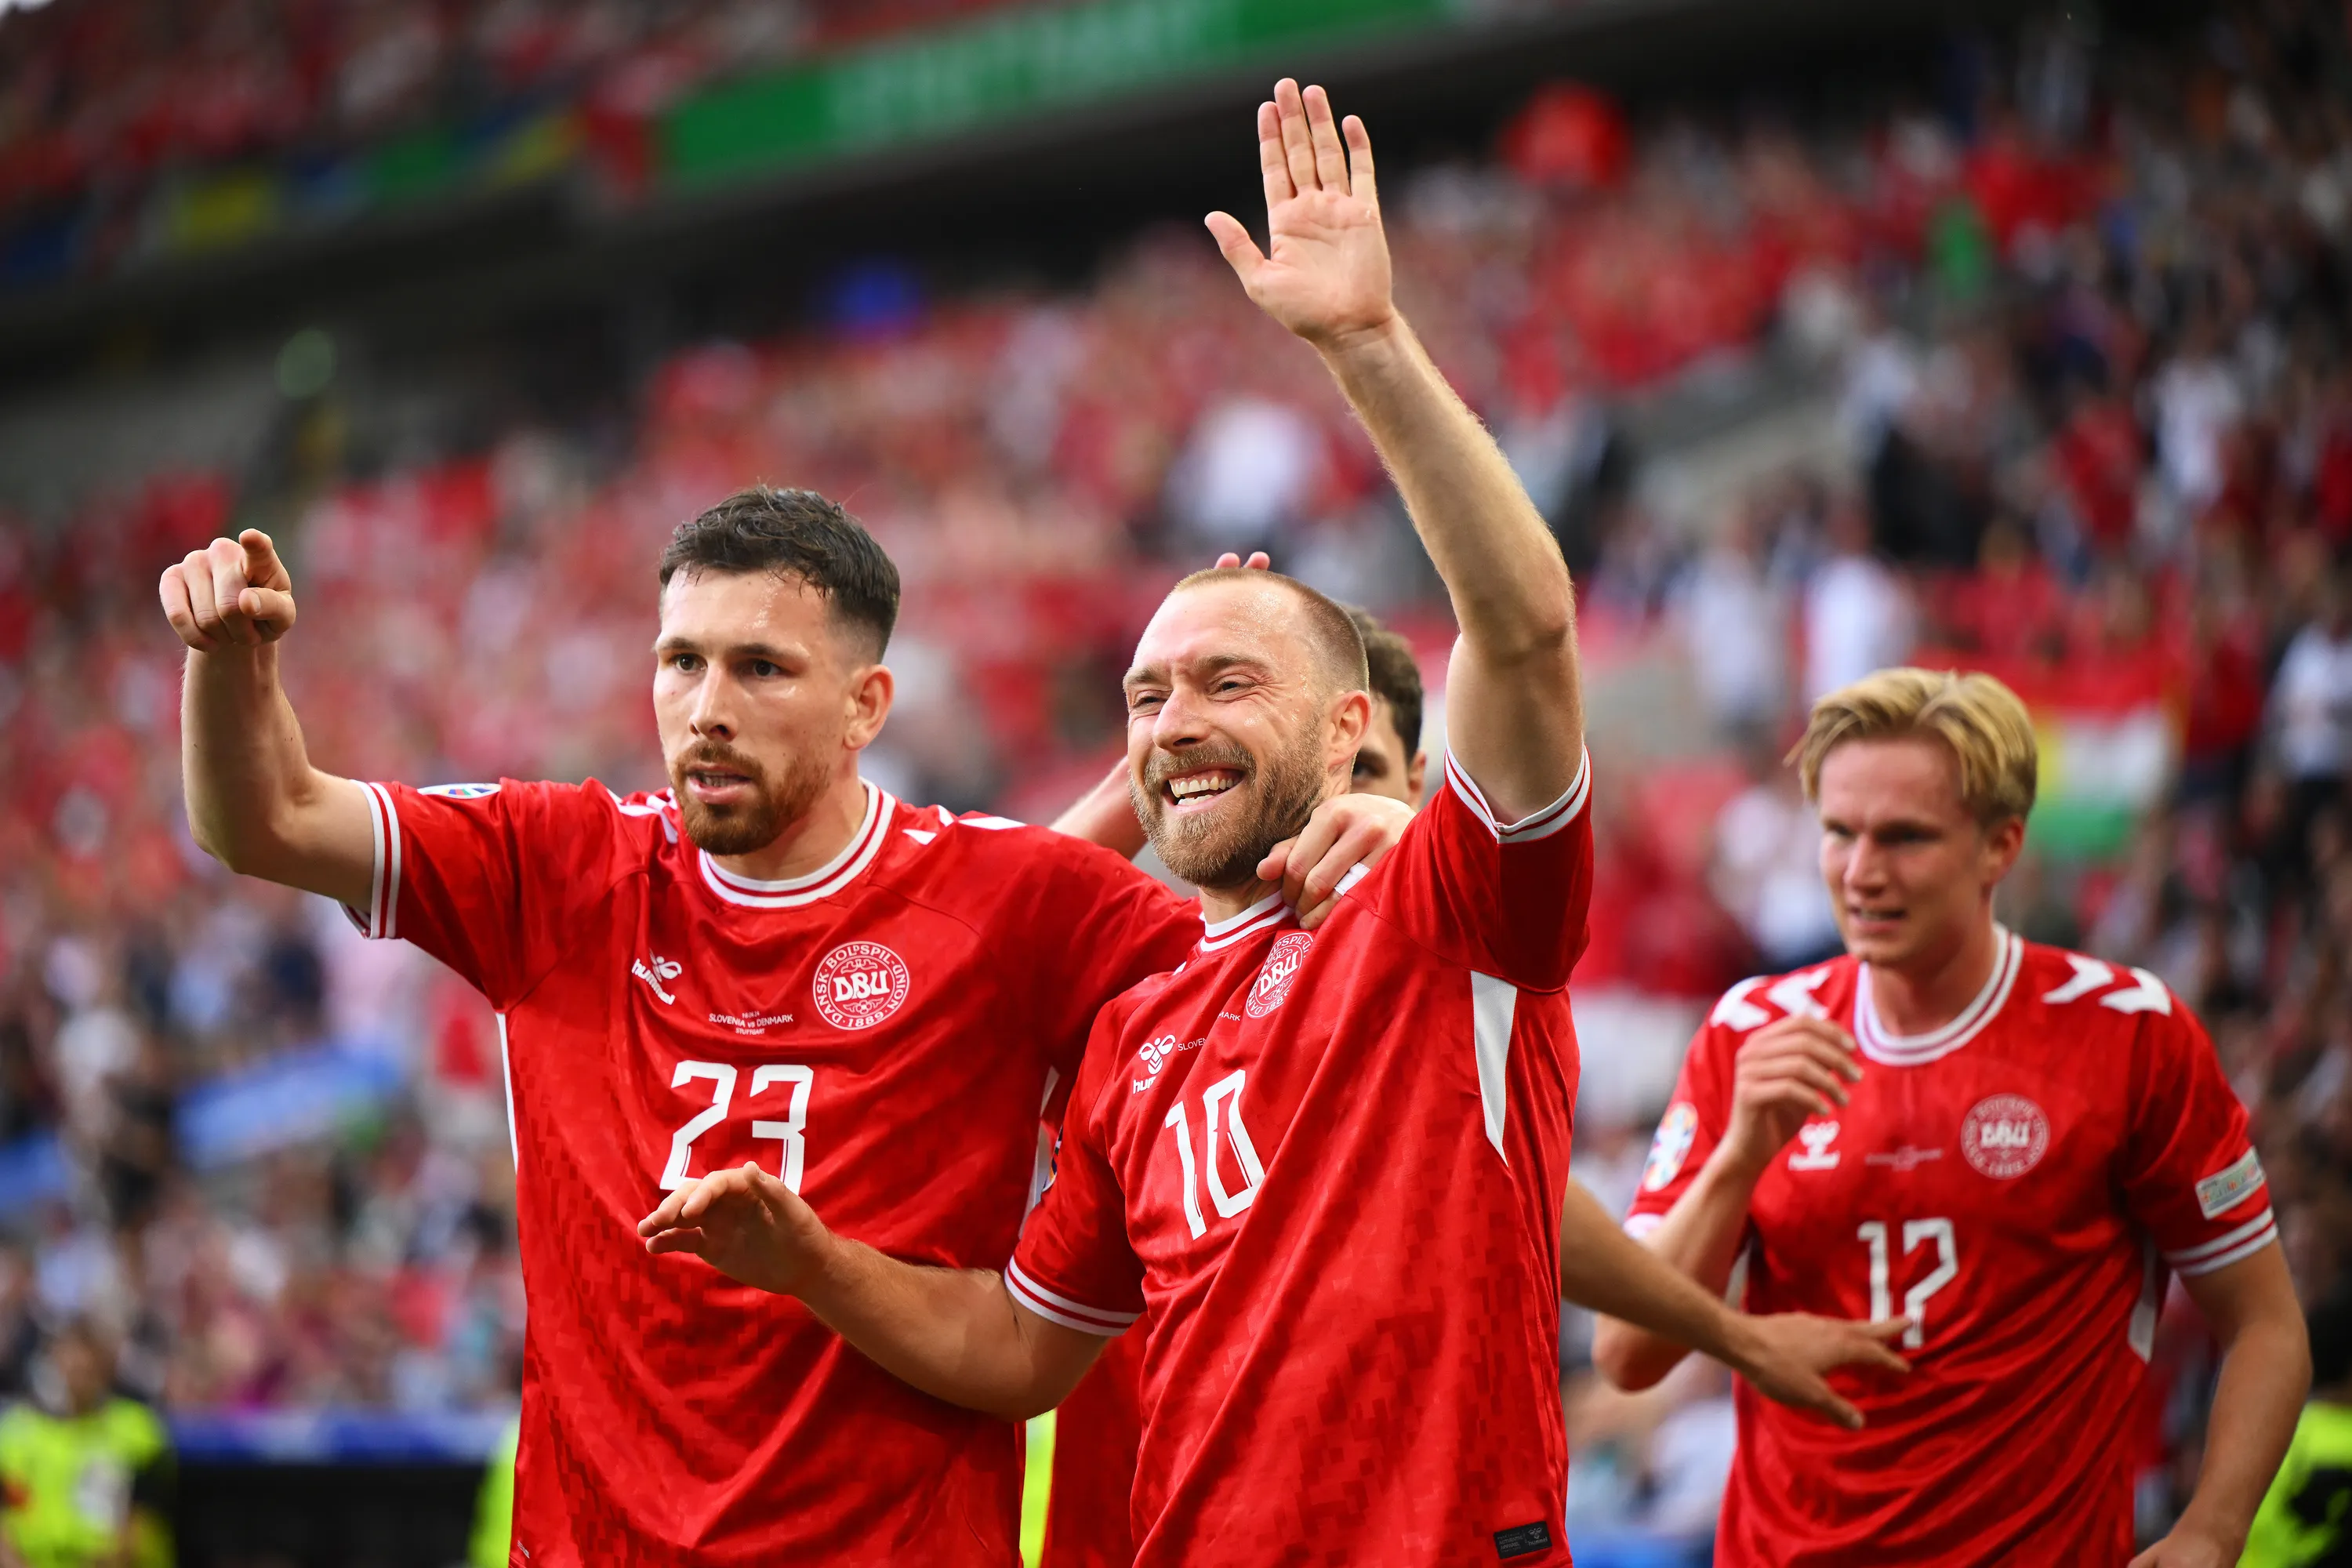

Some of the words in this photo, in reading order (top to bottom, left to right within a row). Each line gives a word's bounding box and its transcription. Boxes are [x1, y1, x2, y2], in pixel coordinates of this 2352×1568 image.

[833, 970, 891, 1002] DBU
[1258, 951, 1299, 997] DBU
[709, 1013, 746, 1027] SLOVENIA
[756, 1014, 793, 1027] DENMARK
[848, 1011, 884, 1027] 1889
[659, 1059, 815, 1196] 23
[1165, 1069, 1266, 1241] 10
[1857, 1216, 1959, 1349] 17
